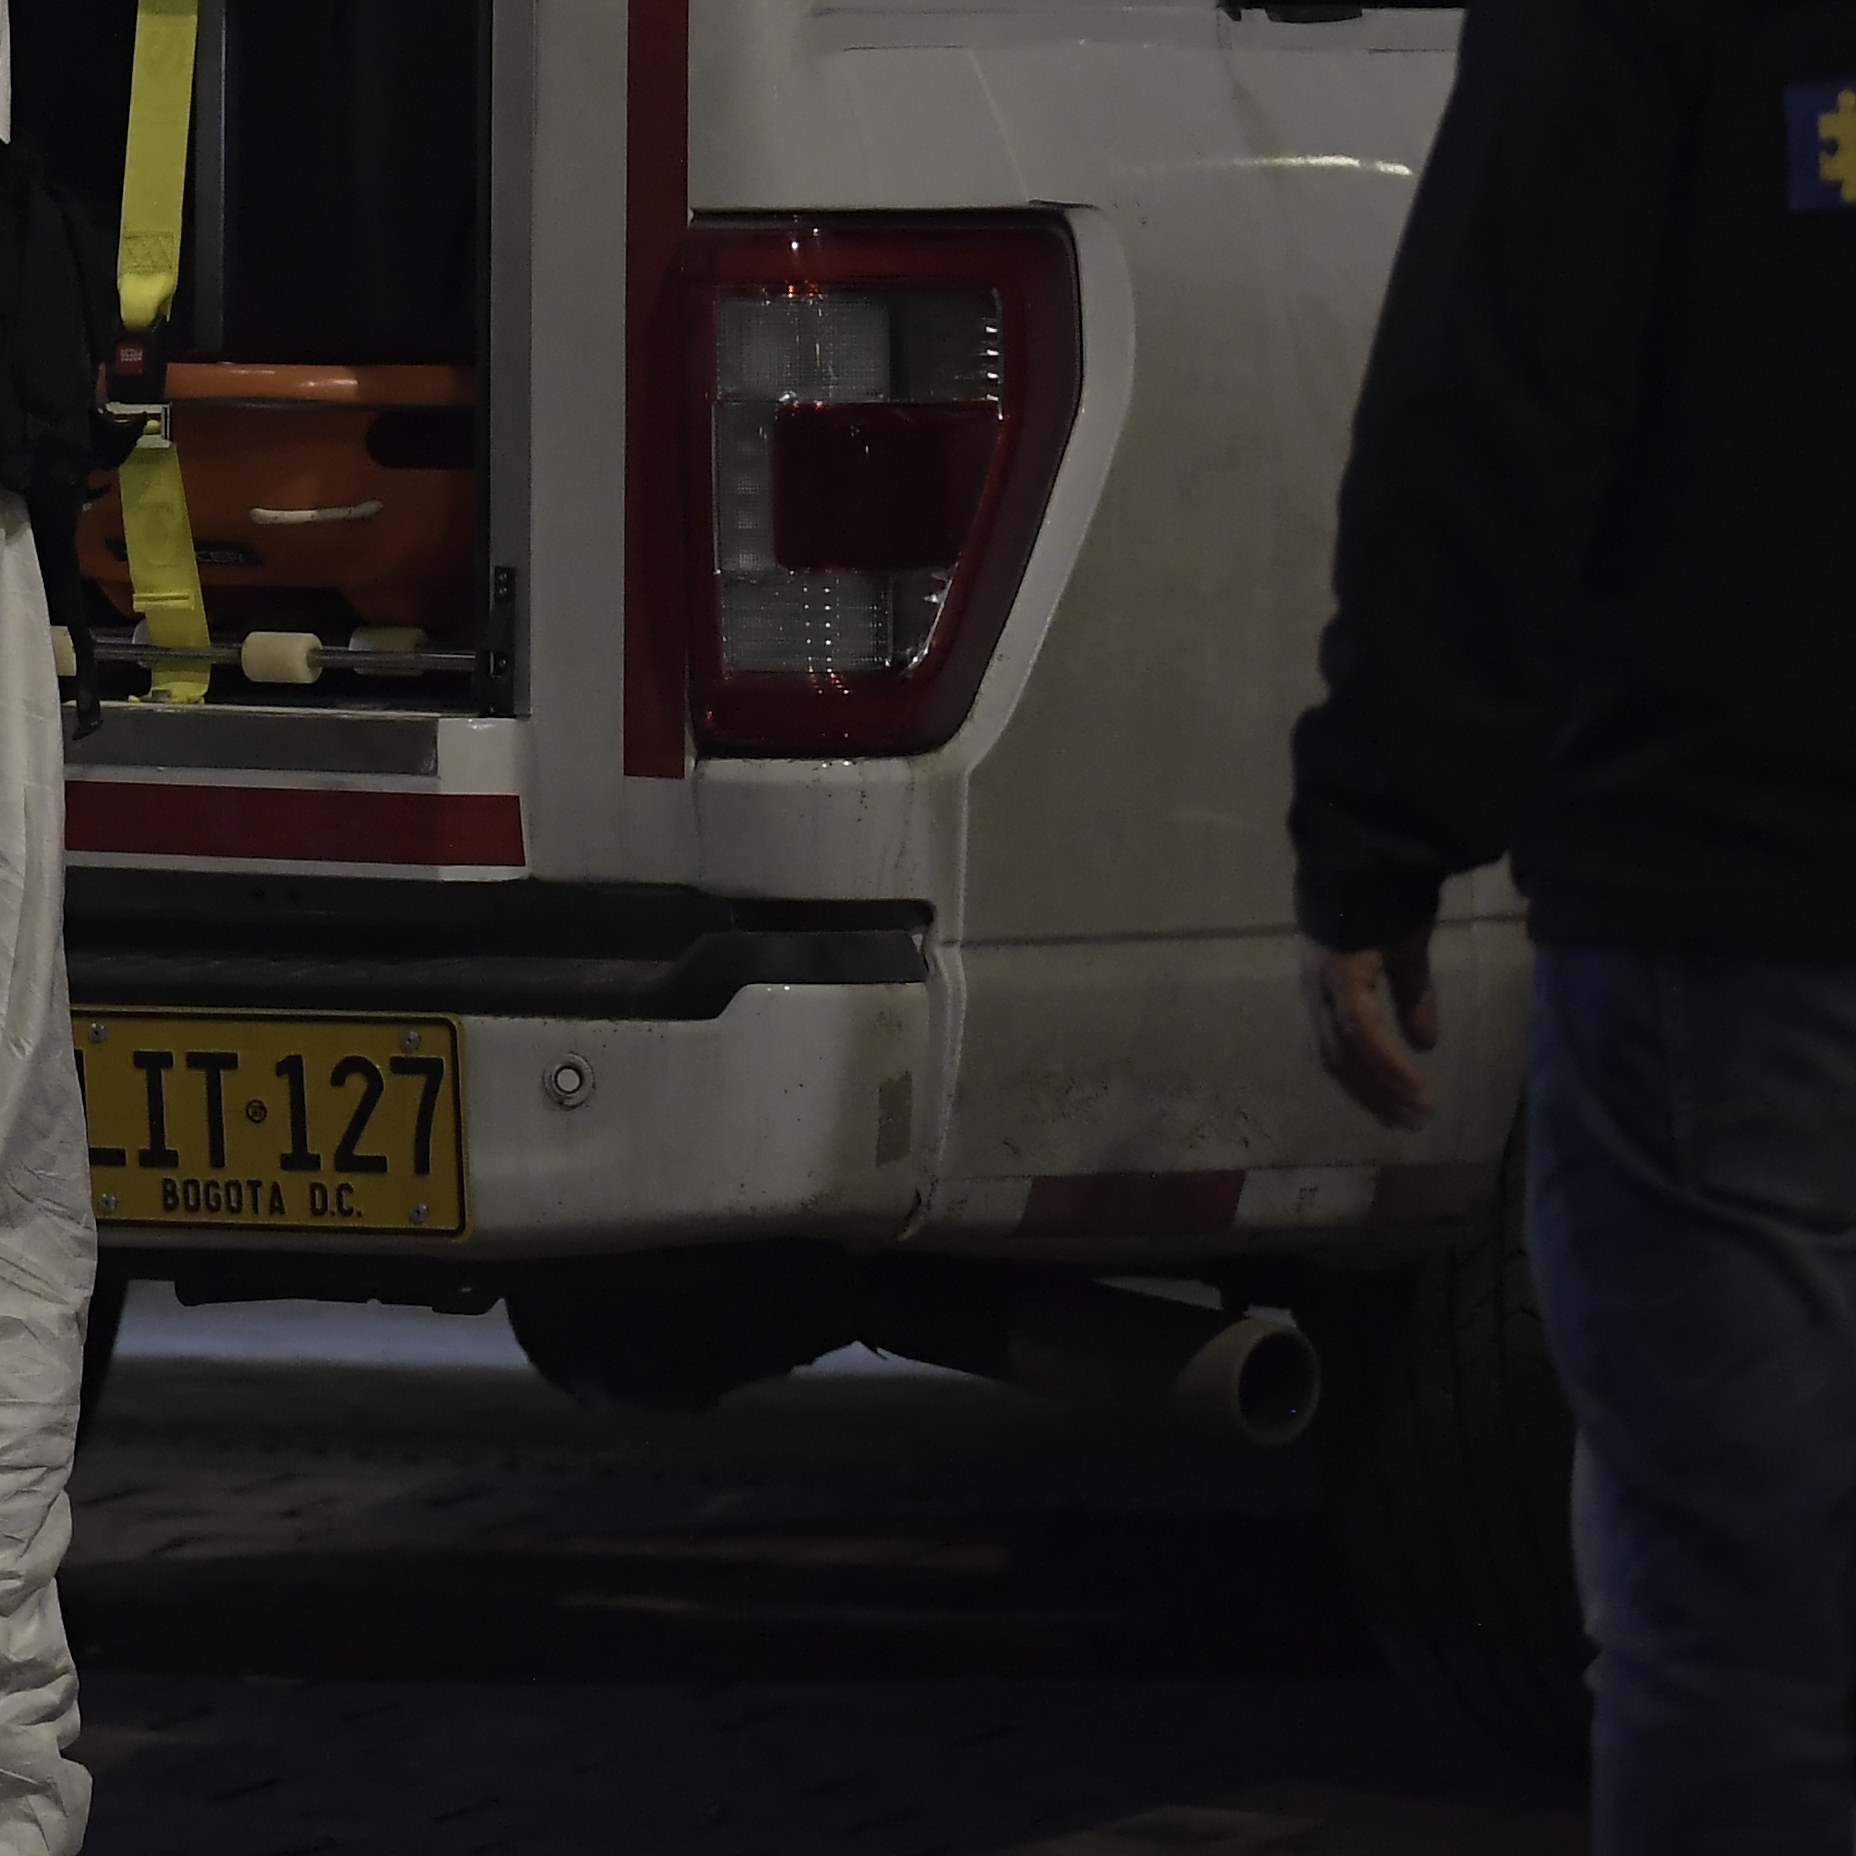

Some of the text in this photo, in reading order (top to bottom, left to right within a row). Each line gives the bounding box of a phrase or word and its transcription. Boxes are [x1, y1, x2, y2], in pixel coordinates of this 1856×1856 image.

[275, 1052, 445, 1176] 127
[161, 1177, 363, 1218] BOGOTA D.C.
